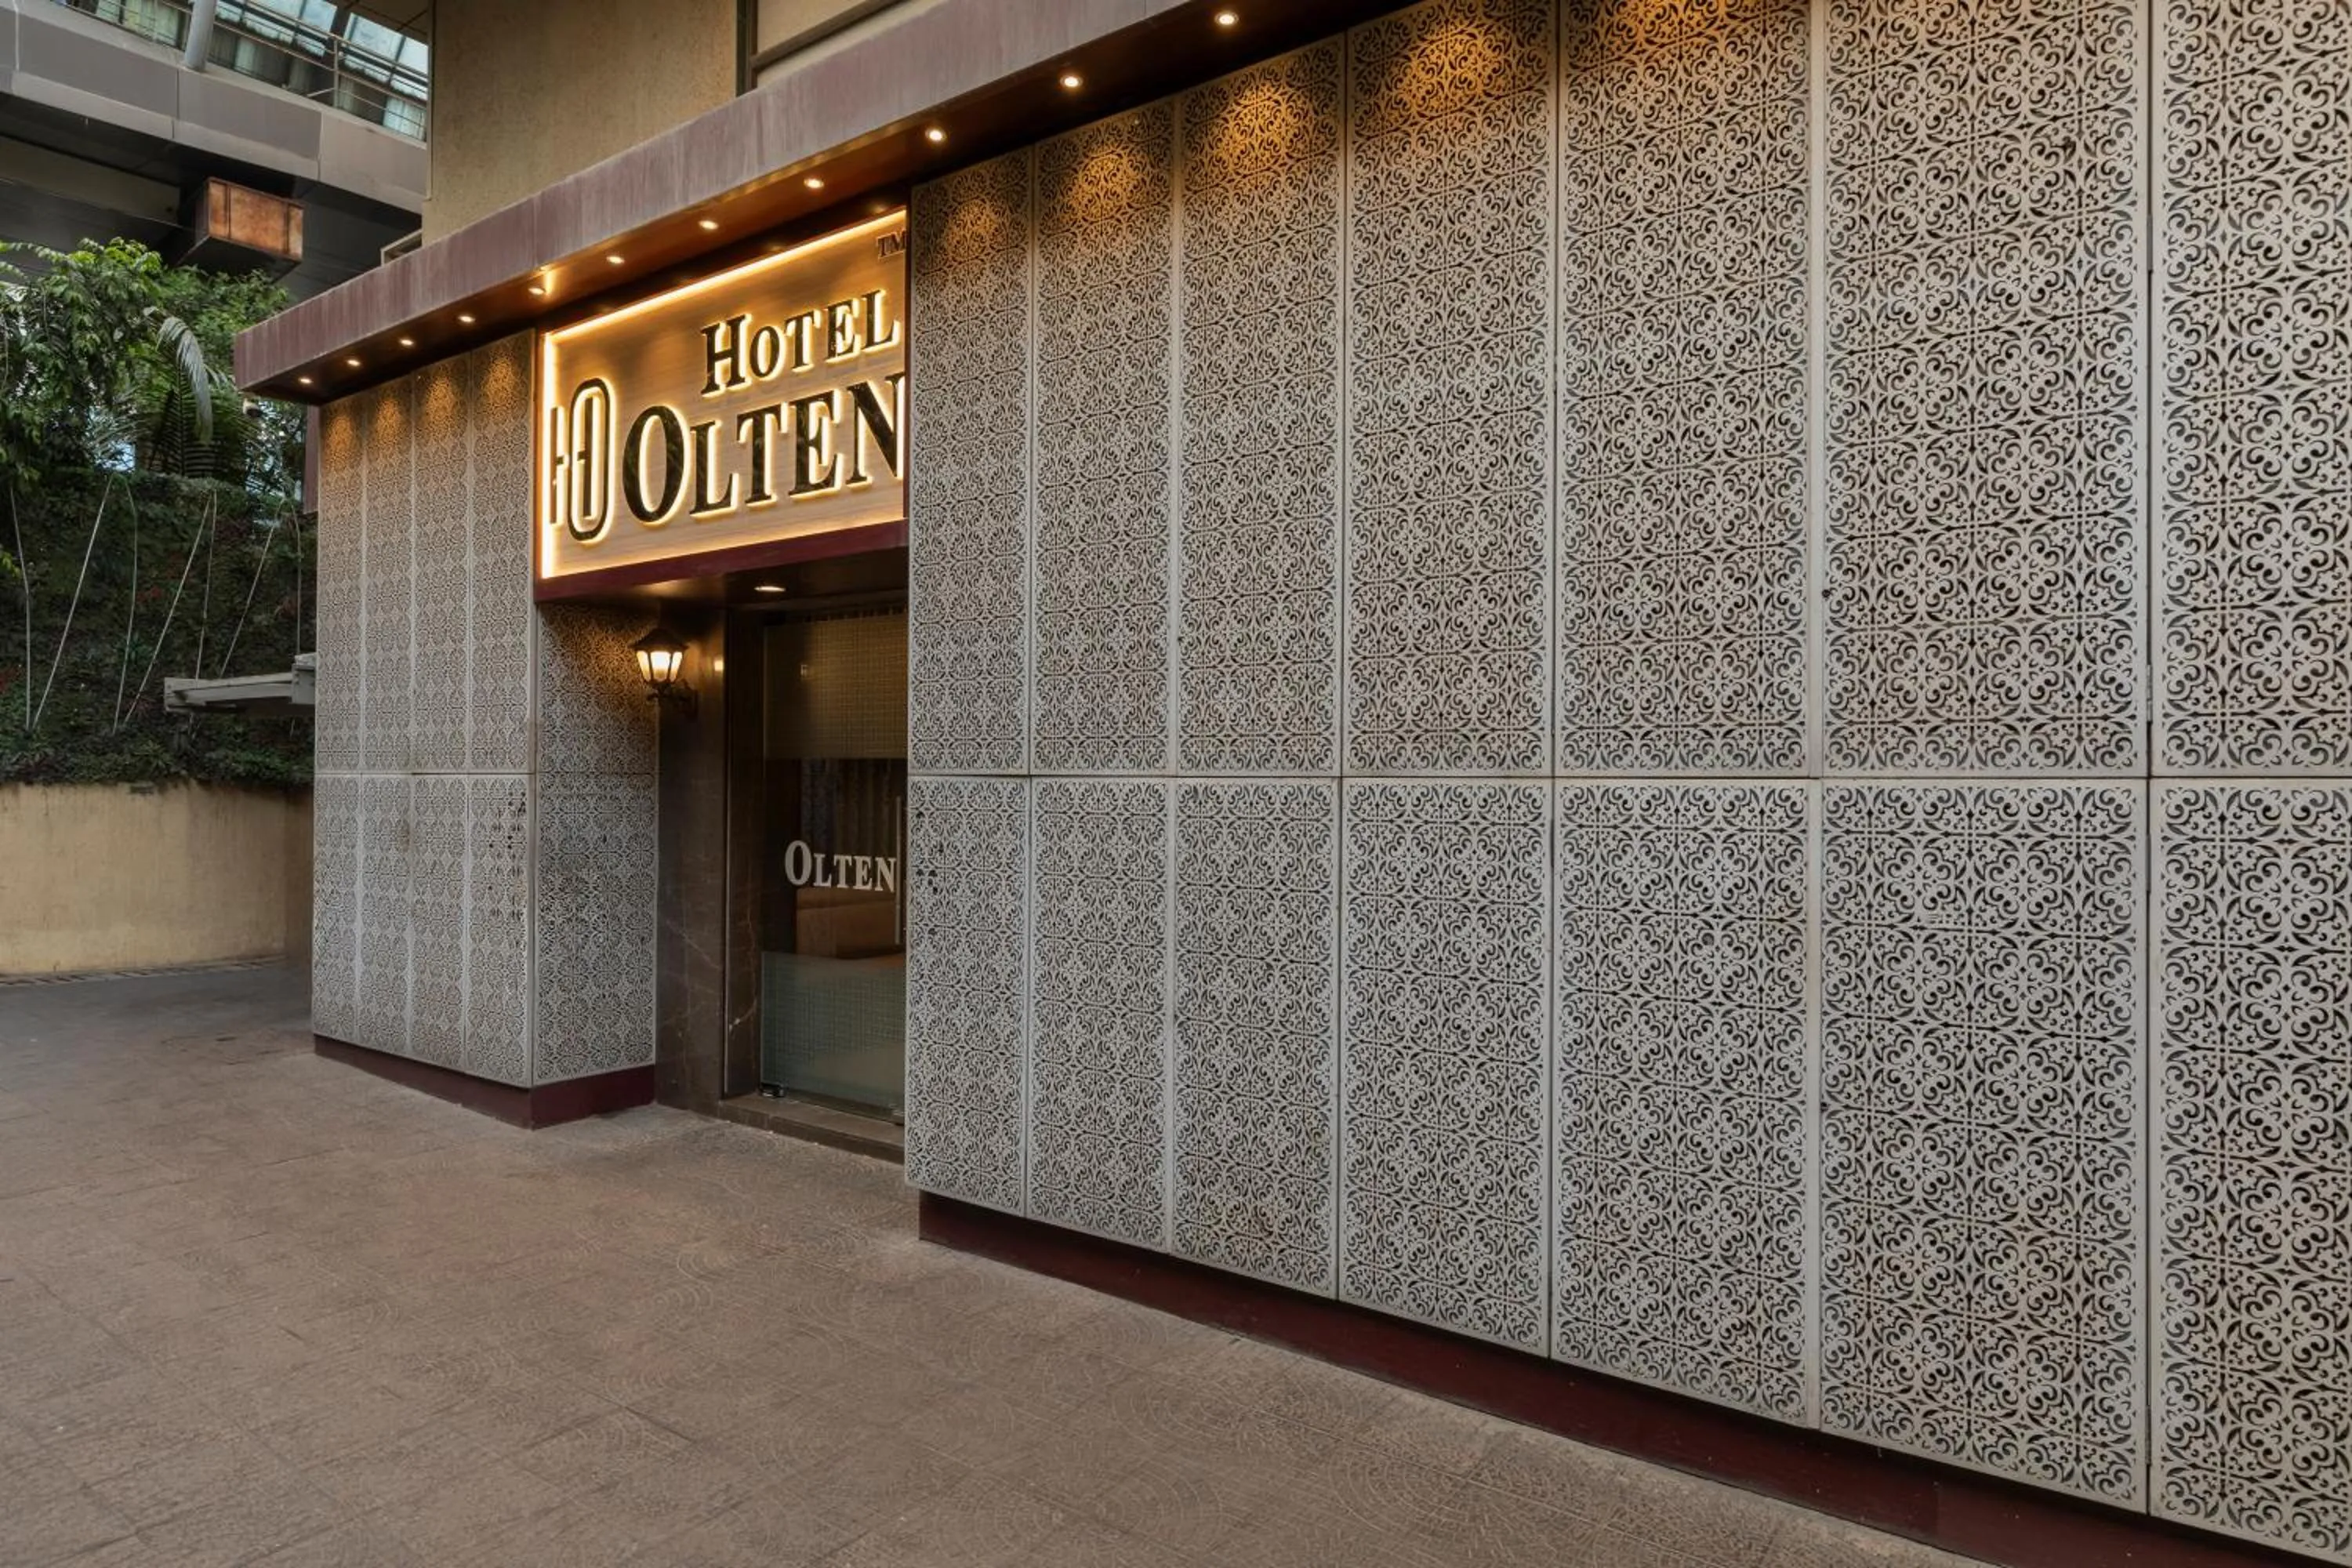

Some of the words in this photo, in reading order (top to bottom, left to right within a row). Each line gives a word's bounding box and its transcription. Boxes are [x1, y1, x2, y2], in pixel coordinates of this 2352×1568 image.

[701, 289, 901, 396] HOTEL
[622, 371, 906, 524] OLTEN
[785, 840, 897, 893] OLTEN
